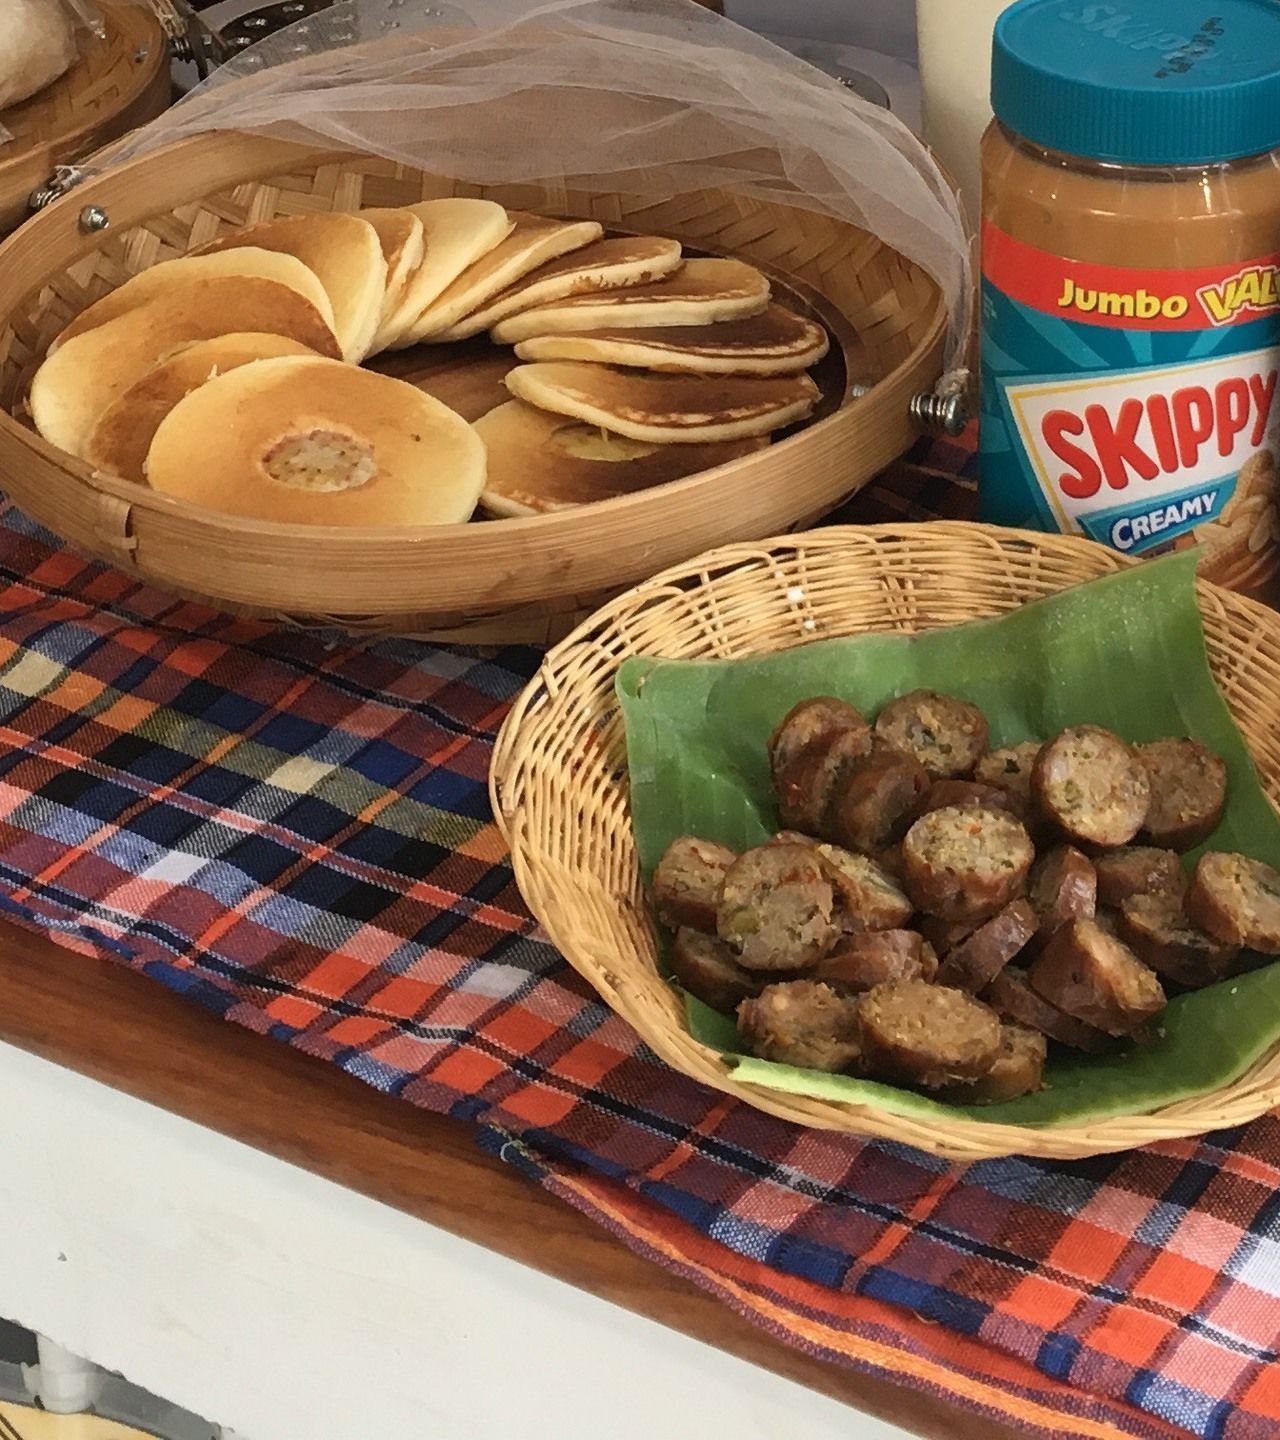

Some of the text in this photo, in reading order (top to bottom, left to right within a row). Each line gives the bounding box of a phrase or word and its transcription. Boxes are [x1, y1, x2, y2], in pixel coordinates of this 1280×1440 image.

[1058, 279, 1188, 320] Jumbo
[1042, 370, 1278, 499] SKIPPY
[1112, 492, 1216, 550] CREAMY
